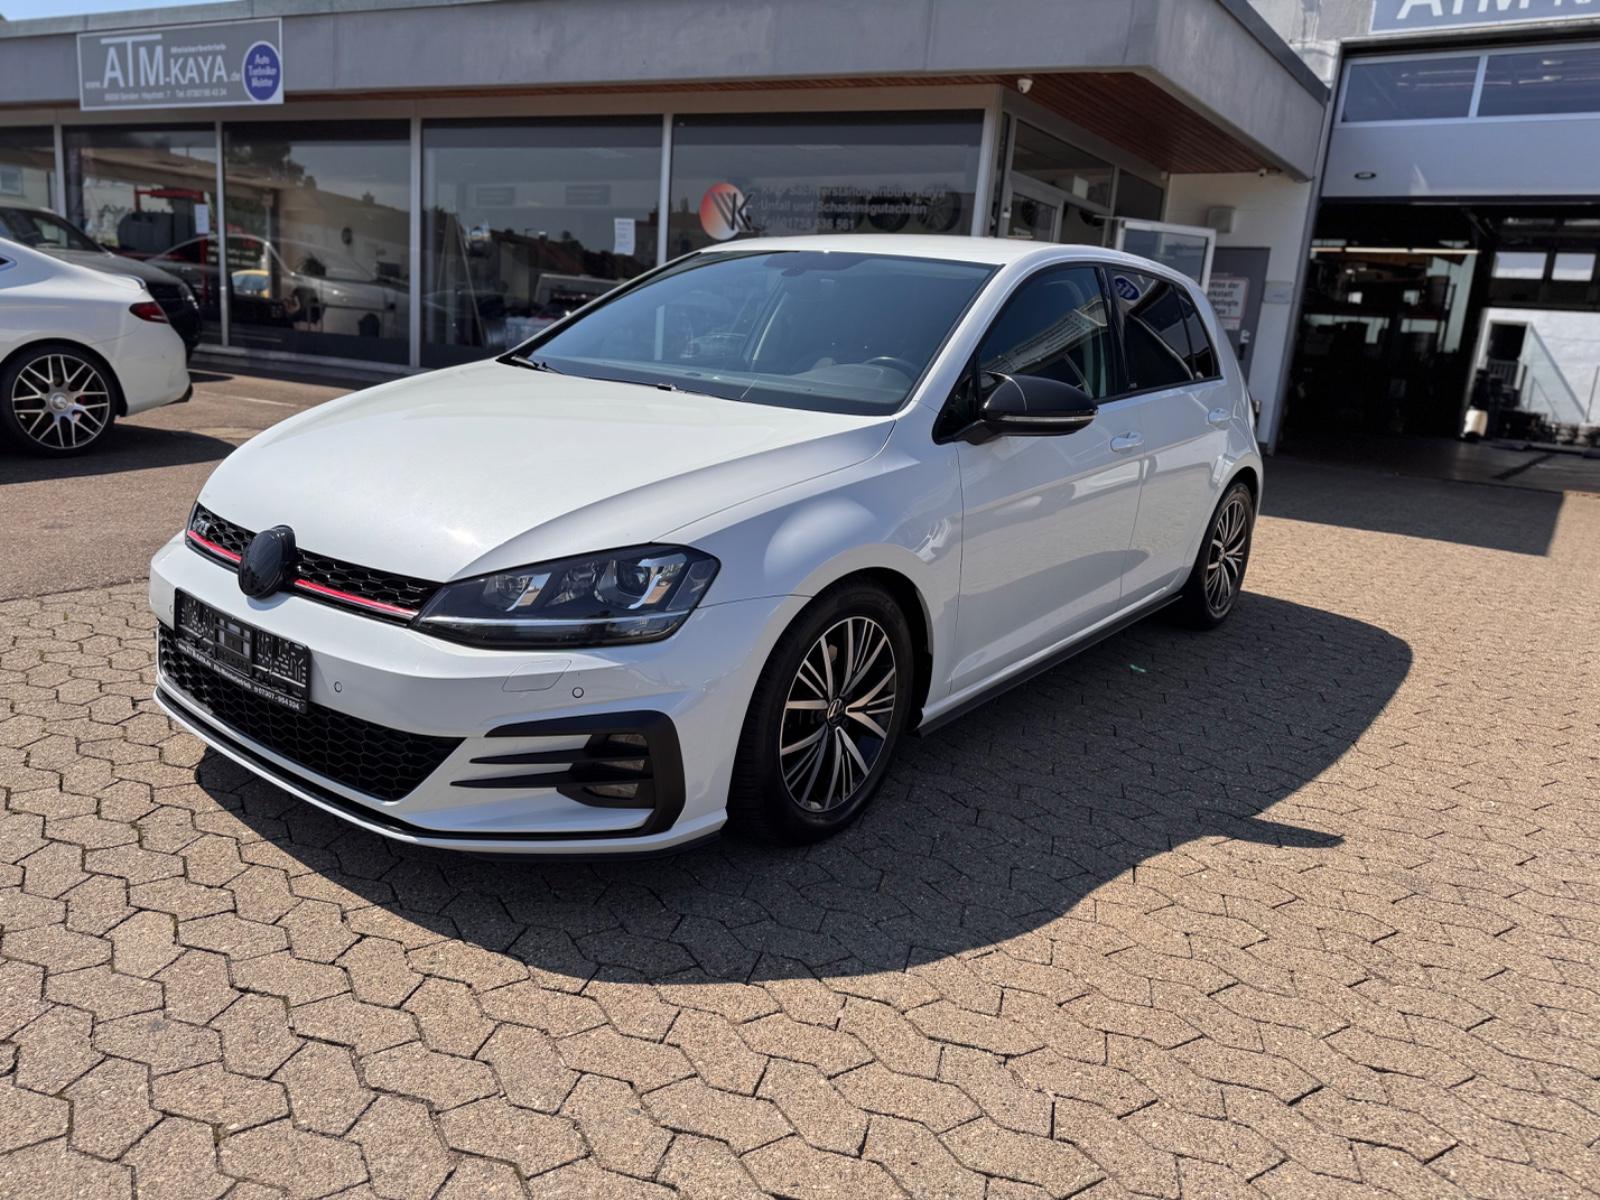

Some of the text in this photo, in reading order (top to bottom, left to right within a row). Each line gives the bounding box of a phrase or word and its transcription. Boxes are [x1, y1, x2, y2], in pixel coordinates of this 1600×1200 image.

[760, 200, 928, 216] Unfall und Schadensgutachten
